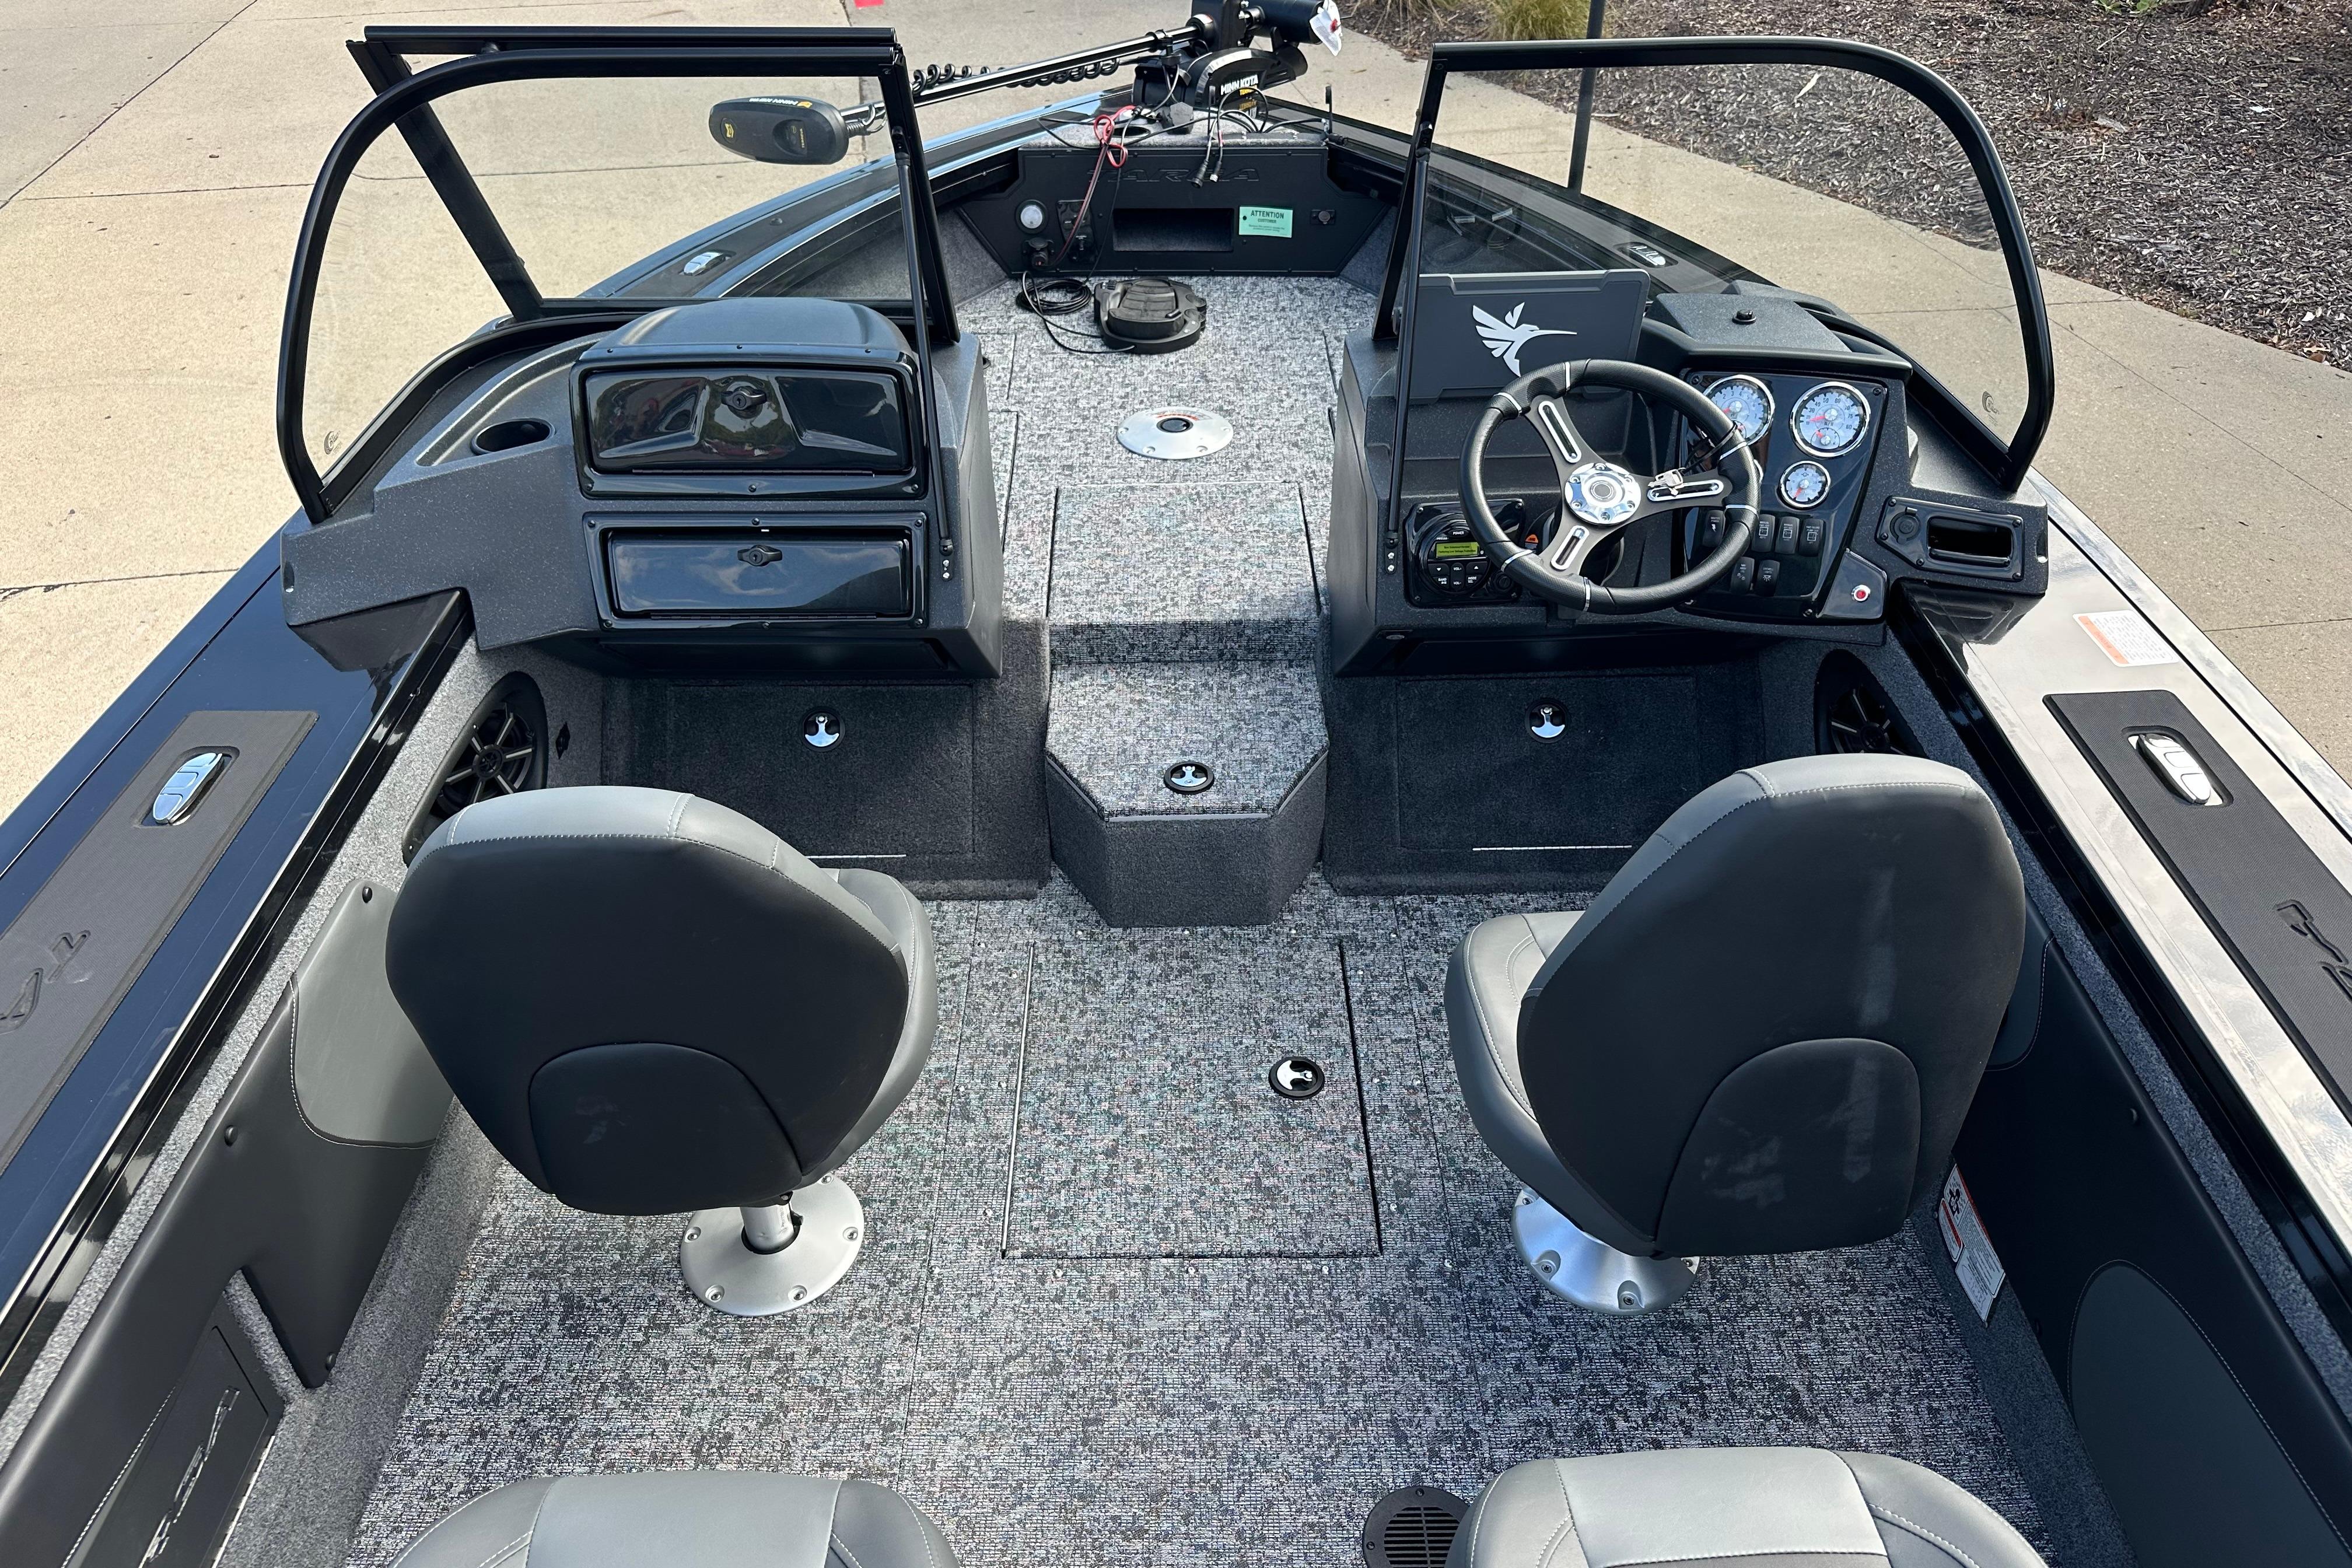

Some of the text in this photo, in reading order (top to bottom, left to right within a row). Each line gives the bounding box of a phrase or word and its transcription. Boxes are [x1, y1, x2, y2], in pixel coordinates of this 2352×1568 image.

[1220, 74, 1258, 95] MINN KOTA
[1250, 210, 1284, 219] ATTENTION
